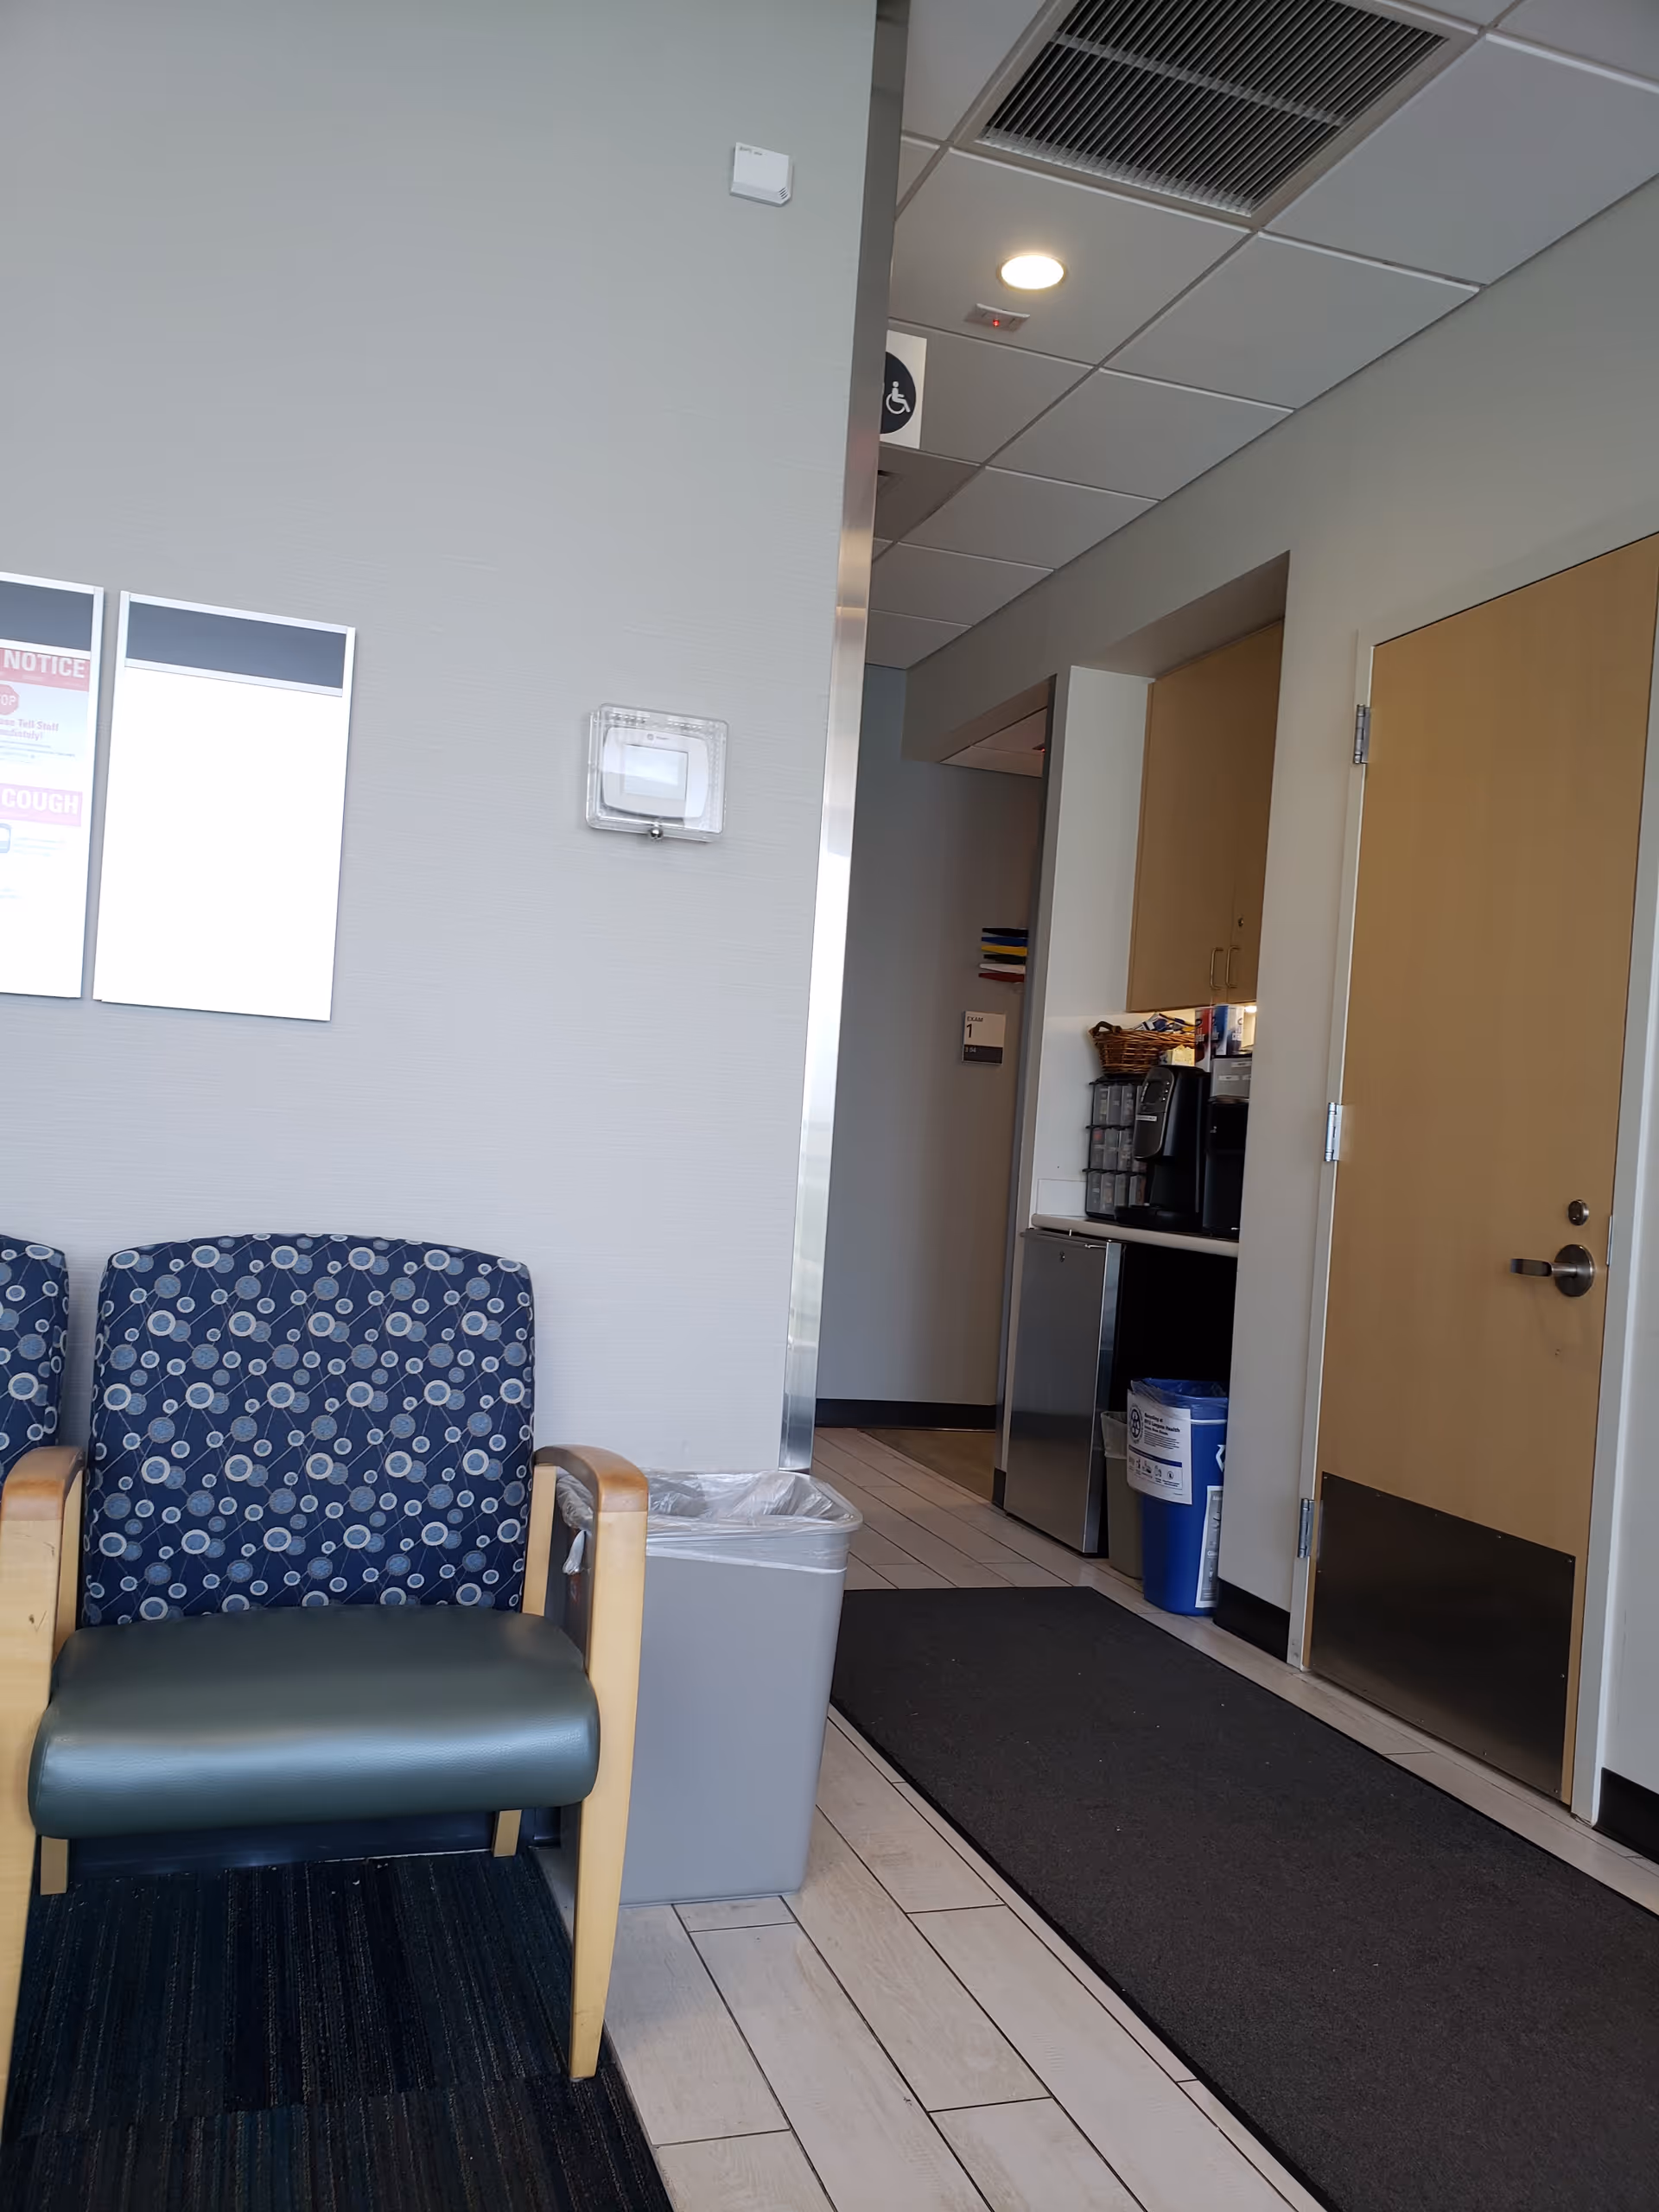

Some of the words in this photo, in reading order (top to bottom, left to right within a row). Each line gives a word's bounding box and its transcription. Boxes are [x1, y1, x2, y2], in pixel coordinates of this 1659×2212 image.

[3, 650, 86, 678] NOTICE
[0, 694, 16, 706] OP
[1, 787, 79, 816] COUGH
[966, 1023, 972, 1038] 1
